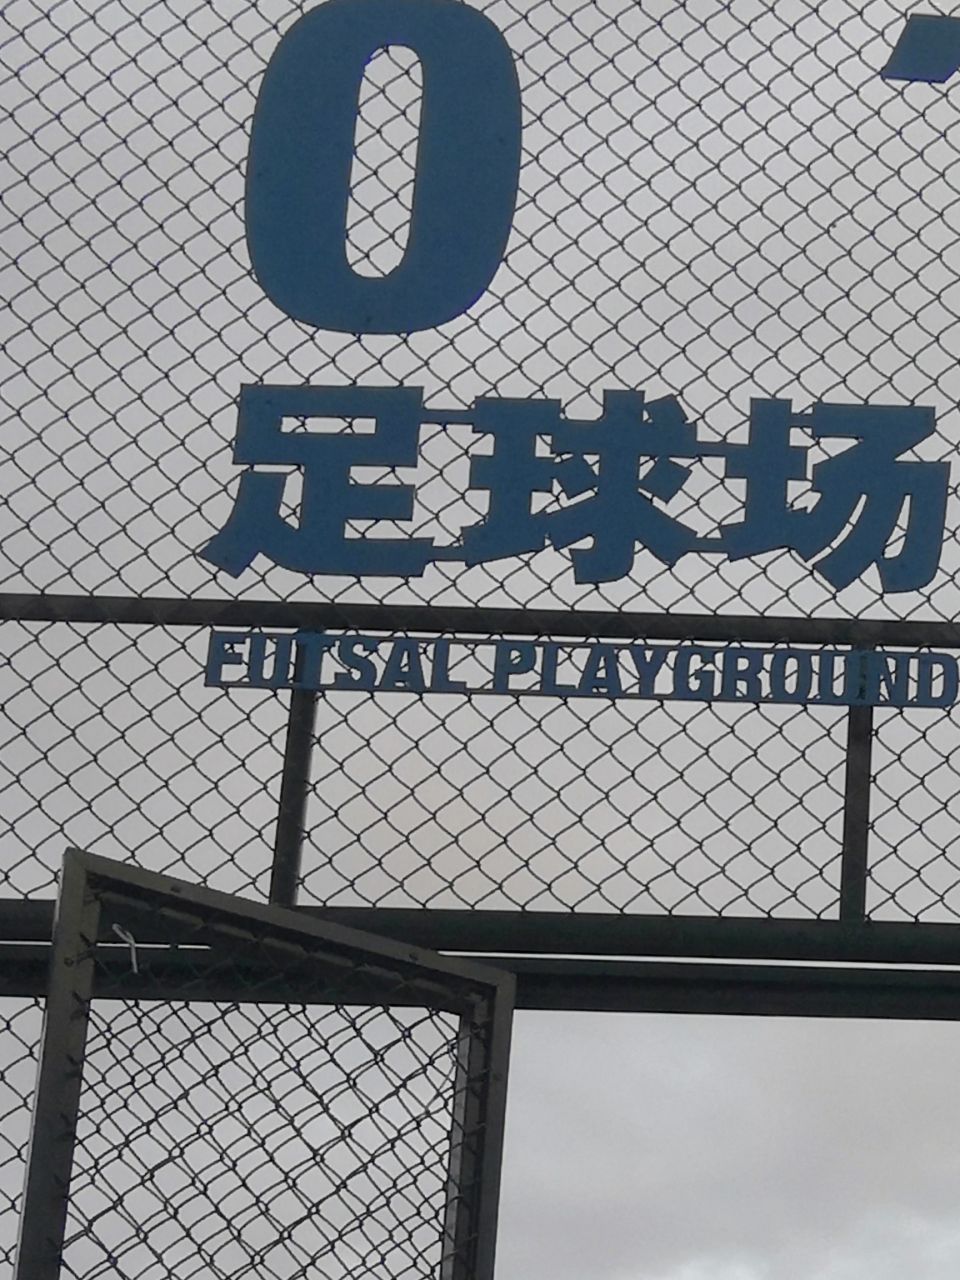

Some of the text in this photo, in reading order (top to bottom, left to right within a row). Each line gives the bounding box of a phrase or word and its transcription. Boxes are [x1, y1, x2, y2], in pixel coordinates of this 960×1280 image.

[201, 383, 951, 594] 足球场
[204, 629, 960, 709] FUTSAL PLAYGROUND
